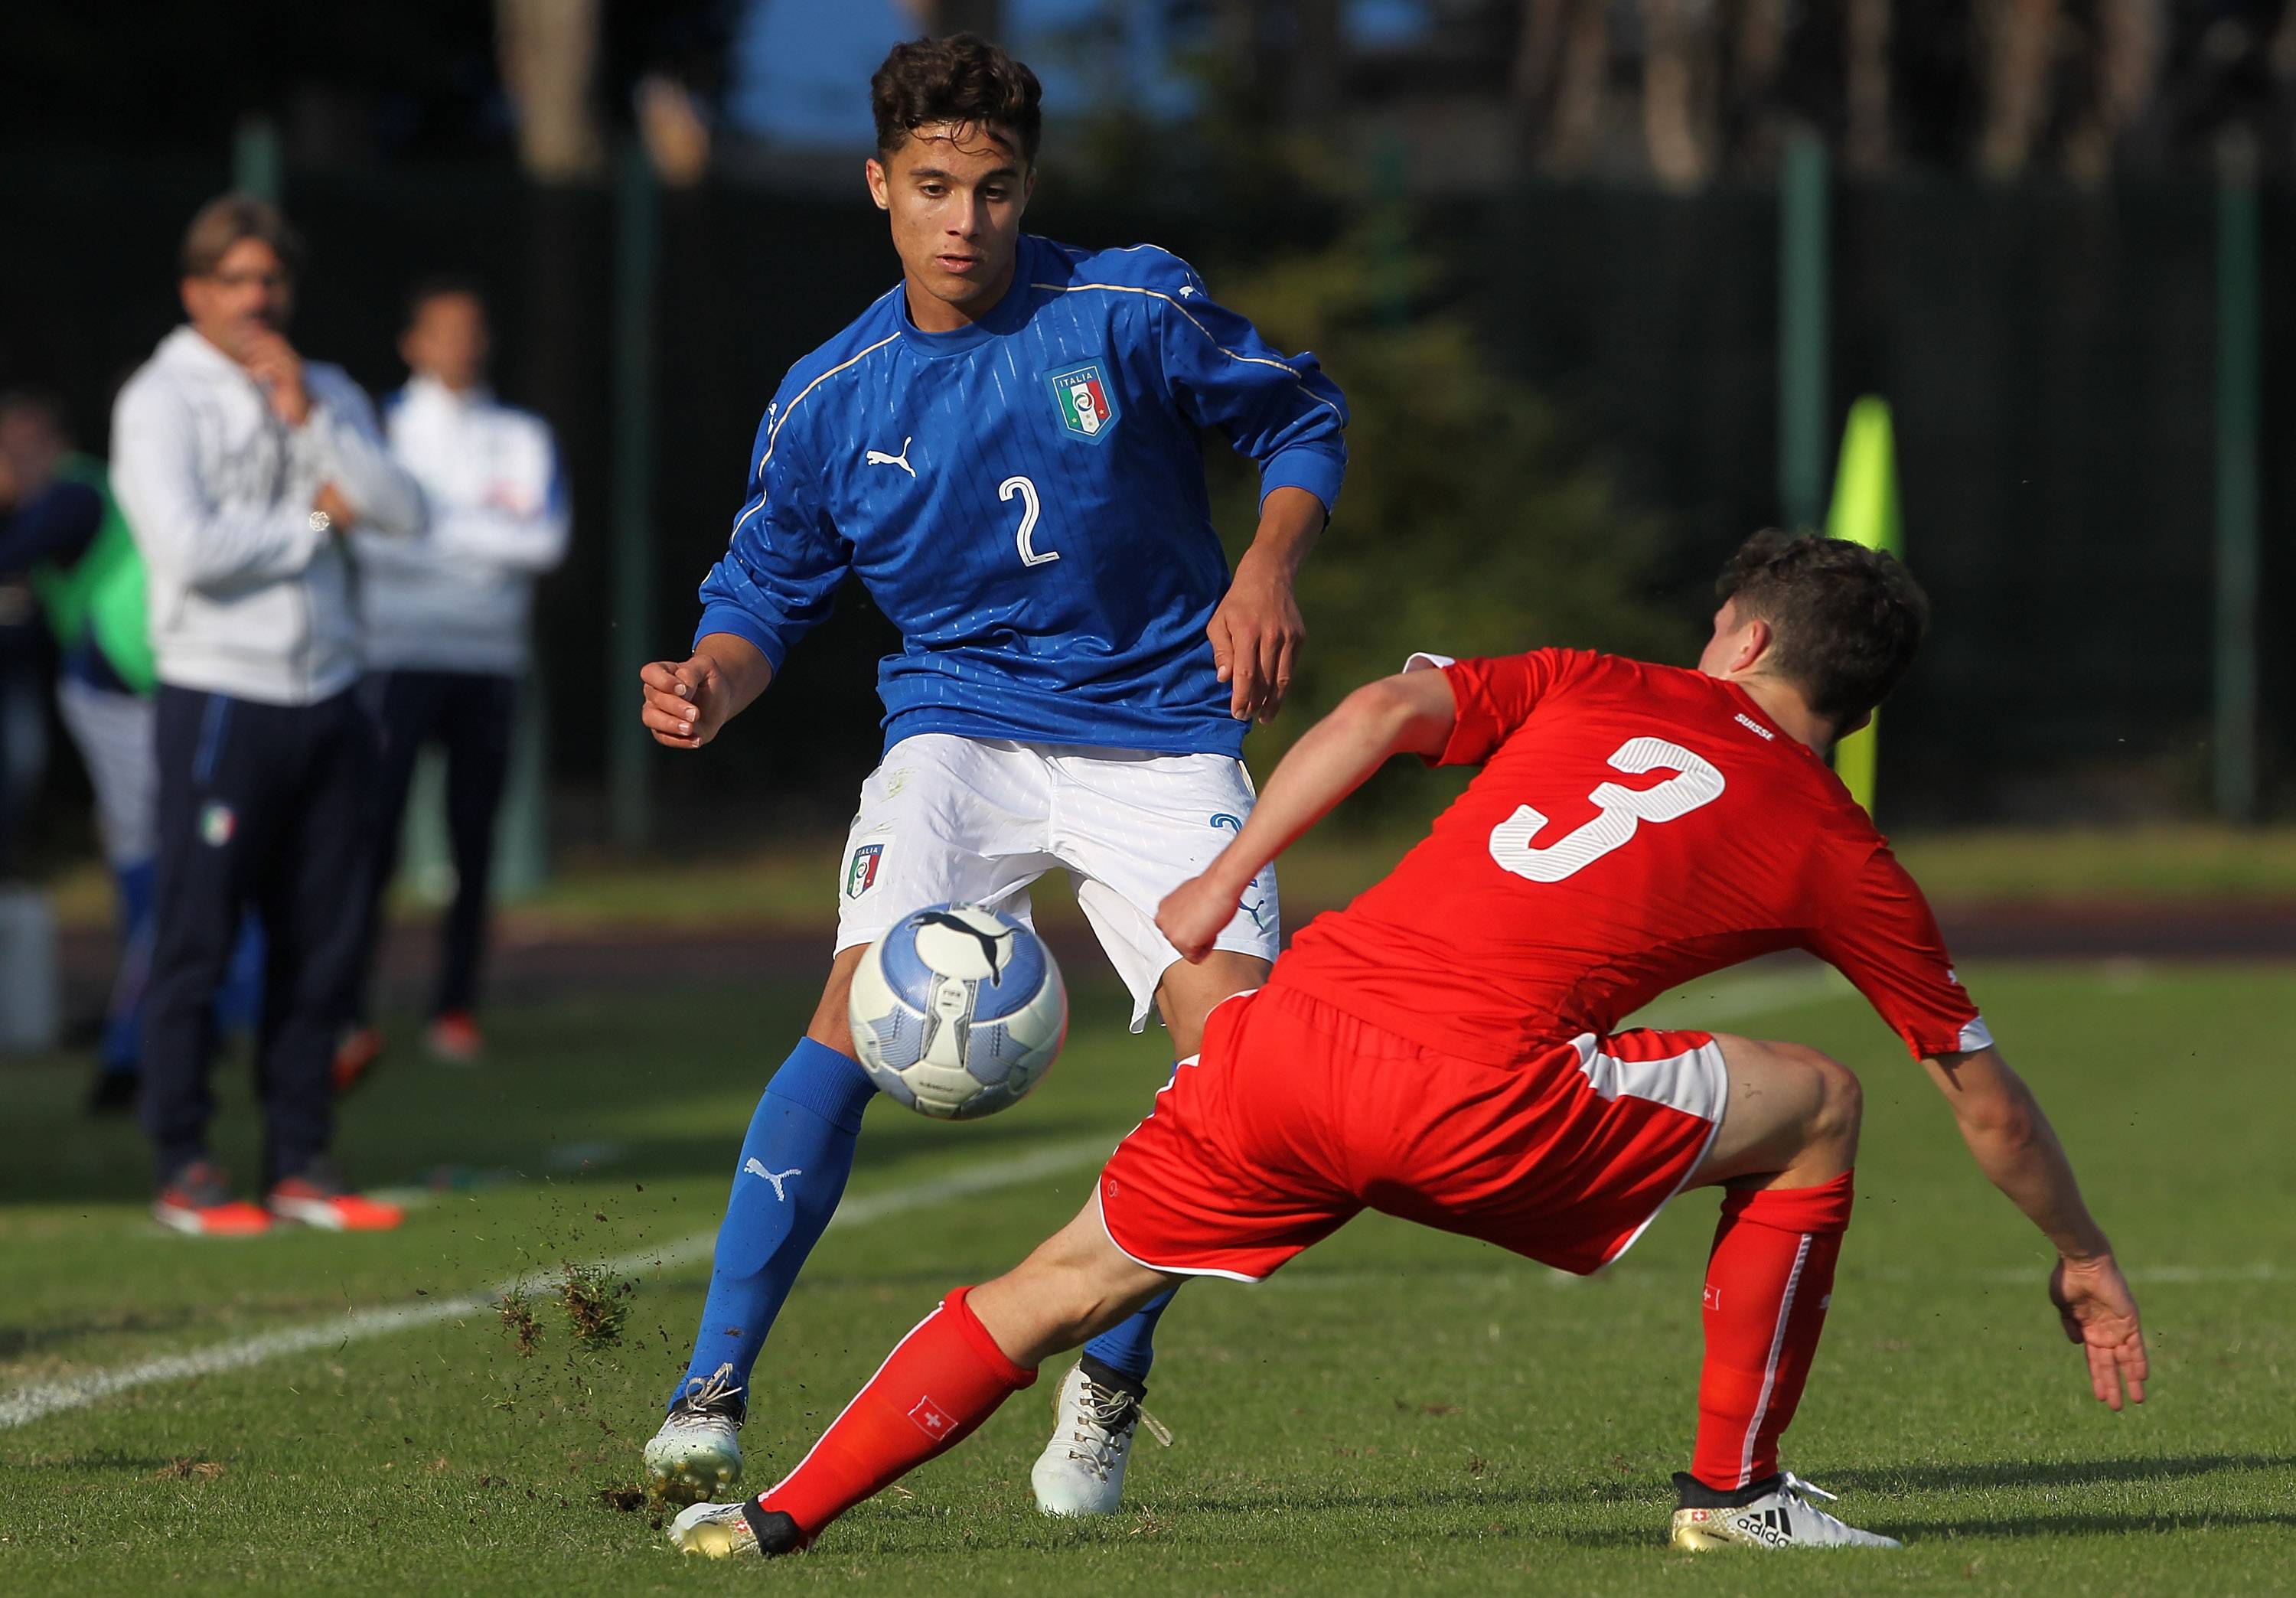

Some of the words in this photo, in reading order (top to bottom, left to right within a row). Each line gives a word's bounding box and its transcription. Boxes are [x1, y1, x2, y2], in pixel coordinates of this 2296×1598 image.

[1059, 372, 1093, 387] ITALIA
[998, 476, 1060, 567] 2
[1489, 736, 1726, 883] 3
[856, 847, 879, 856] ITALIA
[1737, 1518, 1795, 1548] adida
